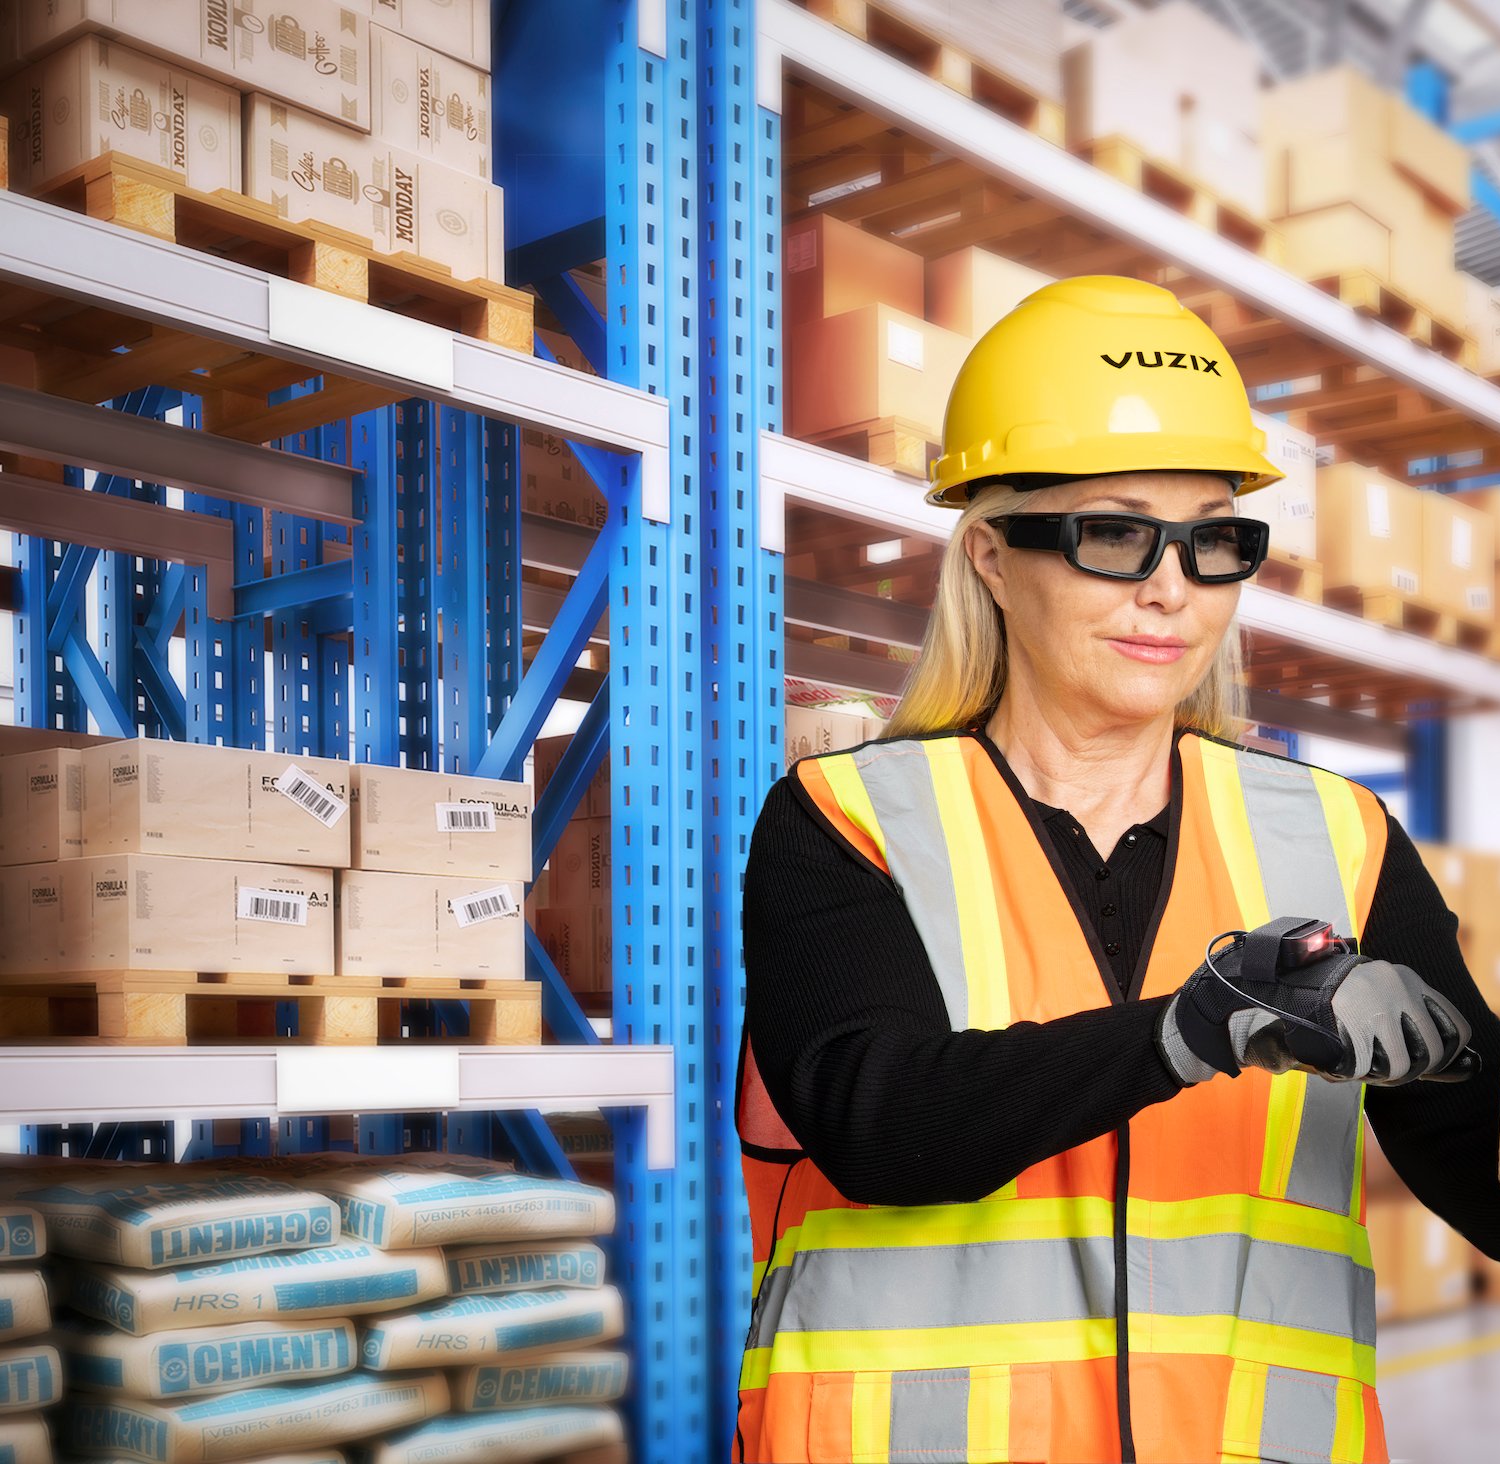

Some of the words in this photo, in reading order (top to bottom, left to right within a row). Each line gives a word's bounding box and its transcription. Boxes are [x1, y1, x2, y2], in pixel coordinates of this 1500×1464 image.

[31, 88, 42, 165] MONDAY
[173, 88, 185, 169] MONDAY
[395, 167, 413, 243] MONDAY
[1100, 351, 1222, 377] VUZIX
[823, 728, 831, 754] DAY
[31, 775, 54, 786] FORMULA
[113, 766, 134, 777] FORMULA
[495, 810, 527, 820] AMPIONS
[523, 806, 528, 814] 1
[97, 881, 123, 891] FORMULA
[323, 893, 328, 901] 1
[341, 1197, 377, 1243] ENT
[166, 1213, 307, 1260] CEMENT
[232, 1244, 370, 1273] PREMIUM
[461, 1253, 577, 1289] CEMENT
[173, 1292, 240, 1313] HRS
[253, 1295, 263, 1310] 1
[416, 1333, 468, 1351] HRS
[479, 1335, 488, 1350] 1
[193, 1332, 334, 1385] CEMENT
[501, 1362, 611, 1400] CEMENT
